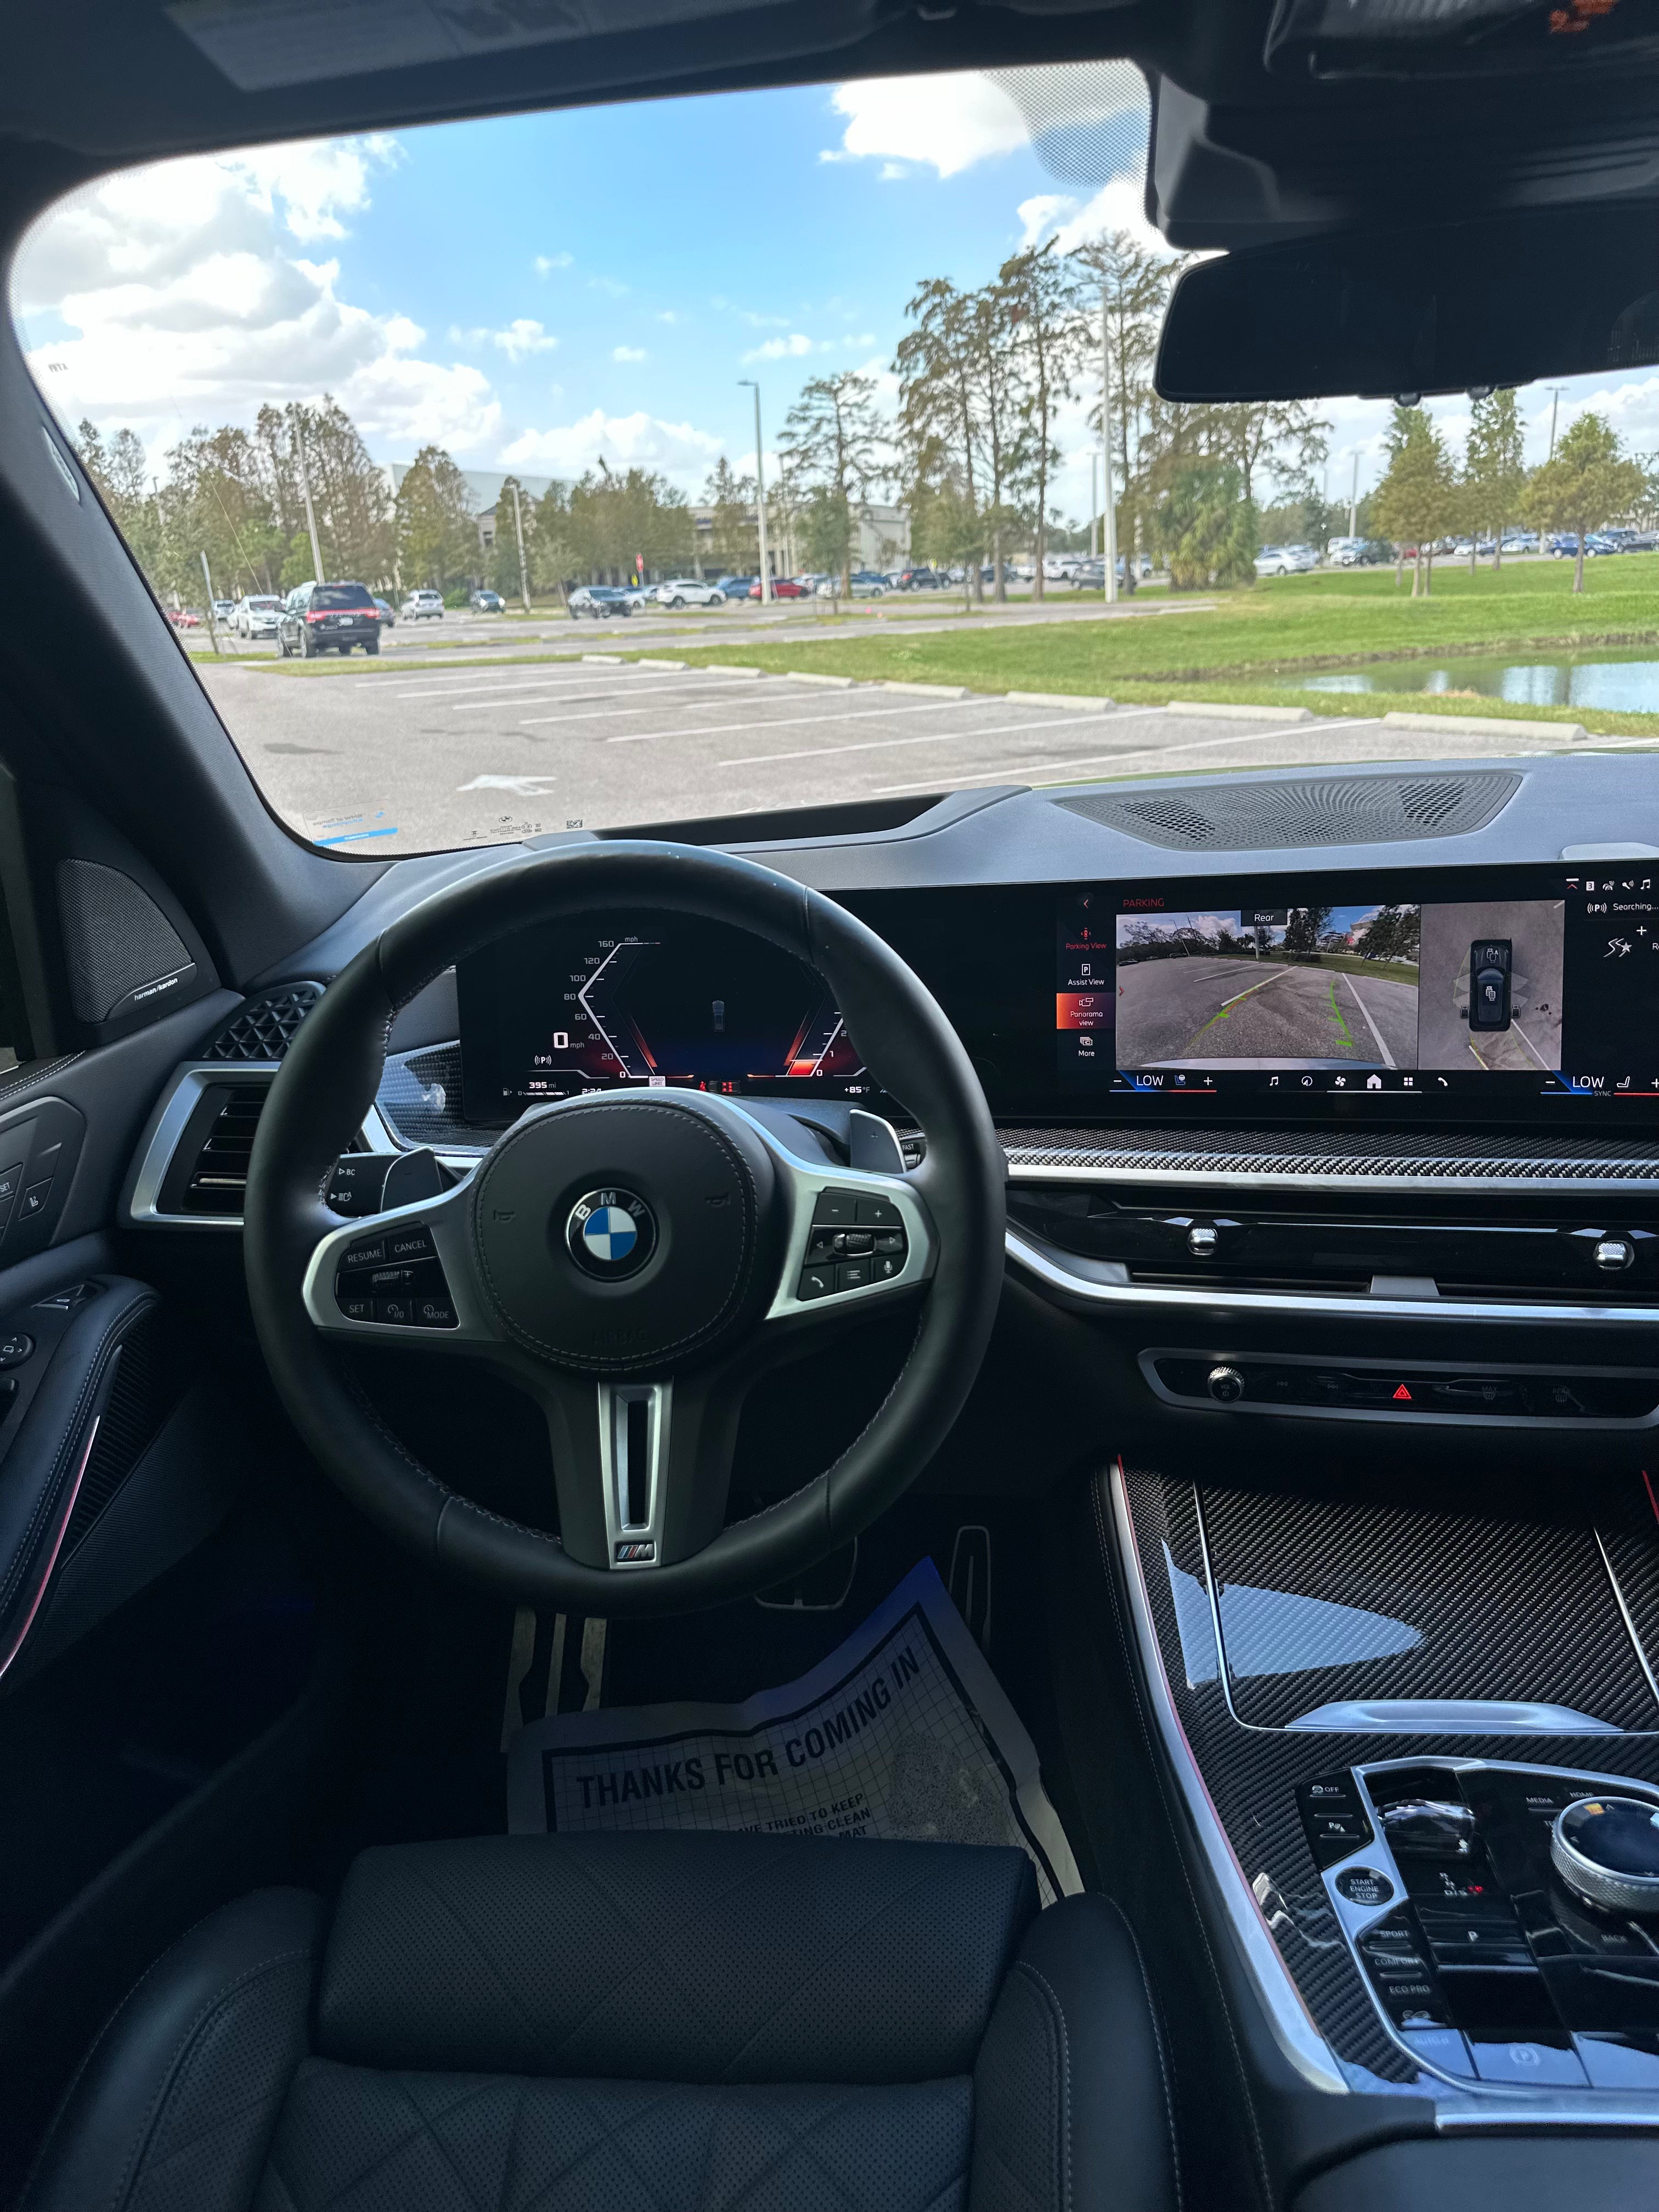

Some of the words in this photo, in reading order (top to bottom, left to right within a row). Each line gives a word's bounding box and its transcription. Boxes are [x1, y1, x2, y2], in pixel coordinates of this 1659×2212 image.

[1123, 898, 1165, 907] PARKING
[1254, 913, 1274, 922] Rear
[1065, 943, 1090, 951] Parking
[134, 978, 178, 1001] harman/kardon
[554, 1031, 568, 1048] 0
[570, 1041, 585, 1049] mph
[1136, 1075, 1164, 1086] LOW
[1572, 1076, 1605, 1088] LOW
[575, 1192, 645, 1220] BMW
[394, 1239, 427, 1253] CANCEL
[347, 1249, 382, 1263] RESUME
[349, 1304, 365, 1313] SET
[426, 1311, 449, 1319] MODE
[576, 1758, 706, 1809] THANKS
[715, 1750, 778, 1785] FOR
[785, 1678, 891, 1767] COMING
[891, 1645, 919, 1689] IN
[766, 1815, 806, 1831] TRIED
[810, 1808, 827, 1821] TO
[831, 1793, 863, 1815] KEEP
[827, 1808, 871, 1830] CLEAN
[839, 1825, 866, 1838] MAT
[1379, 1930, 1409, 1939] SPORT
[1467, 1931, 1479, 1942] P
[1389, 1985, 1408, 1994] ECO
[1409, 1985, 1431, 1994] PRO
